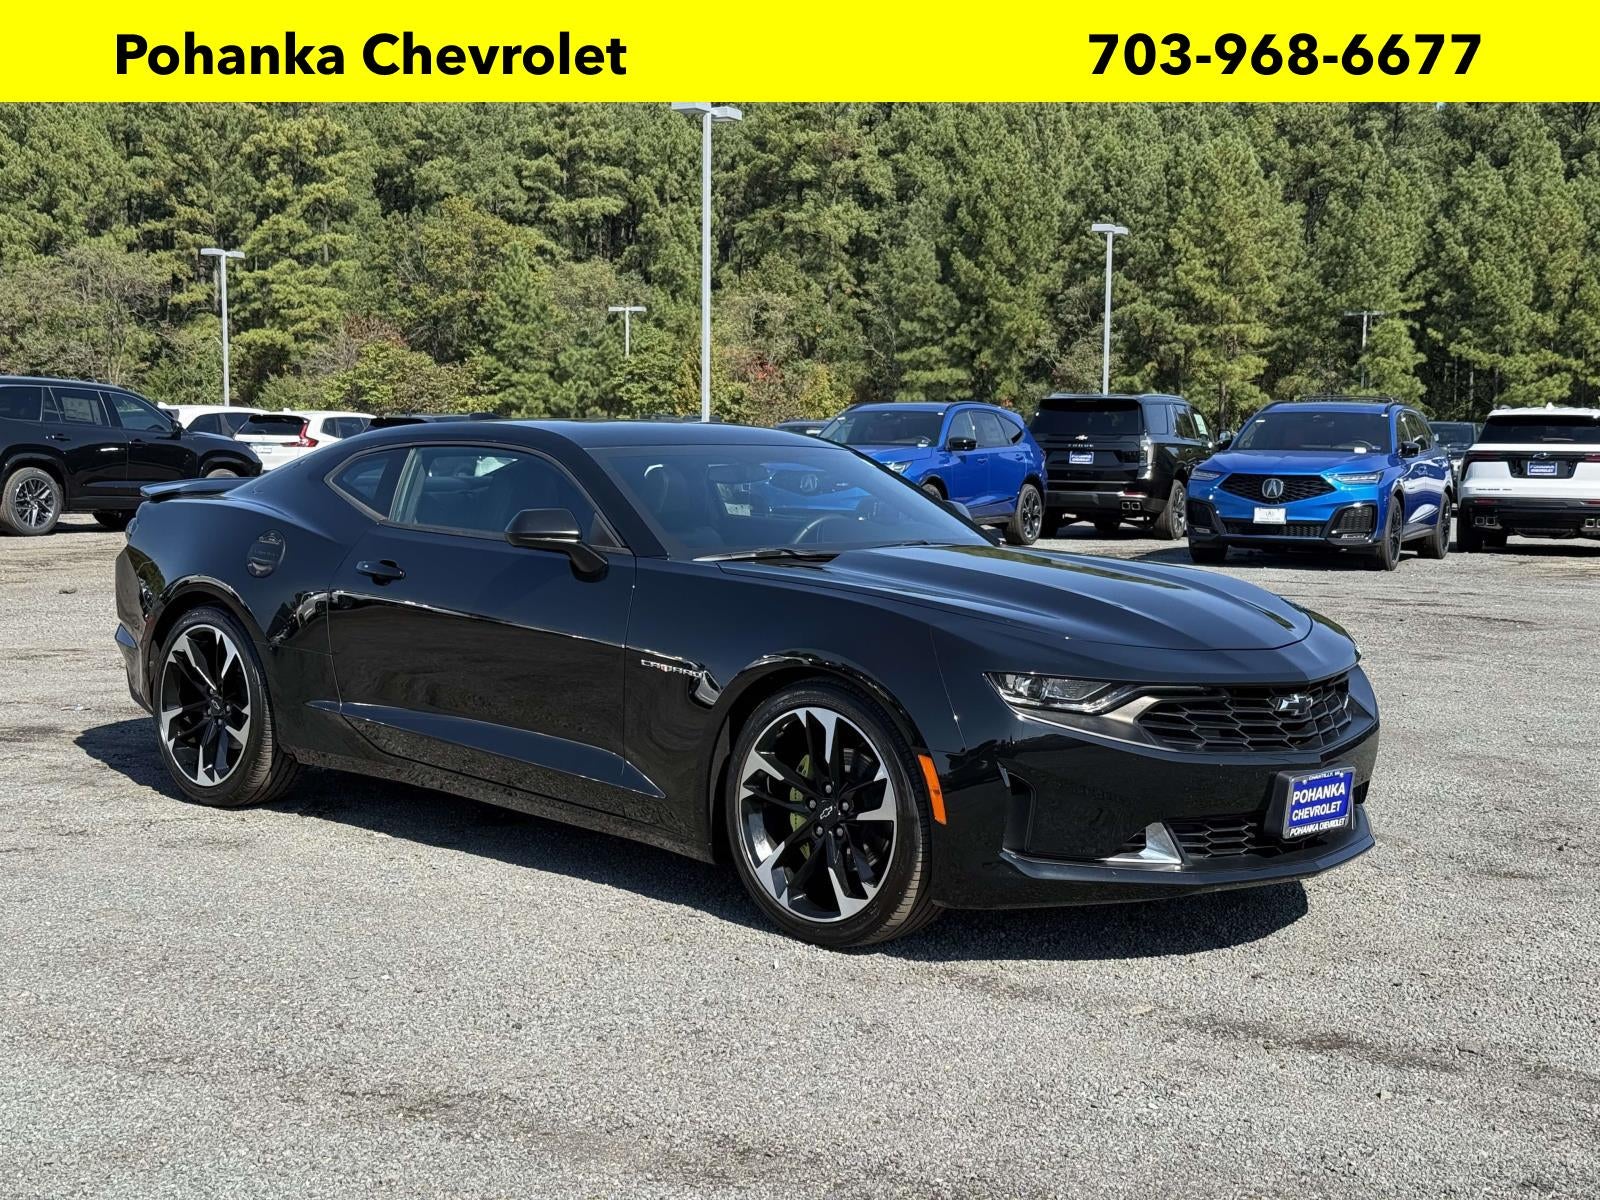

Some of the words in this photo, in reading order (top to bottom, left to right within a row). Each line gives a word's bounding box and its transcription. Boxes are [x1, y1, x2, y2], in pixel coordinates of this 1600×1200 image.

[641, 659, 703, 679] CAMARO
[1292, 782, 1346, 806] POHANKA
[1292, 800, 1342, 821] CHEVROLET
[1290, 822, 1319, 837] POHANKA
[1319, 818, 1345, 831] CHEVROLET
